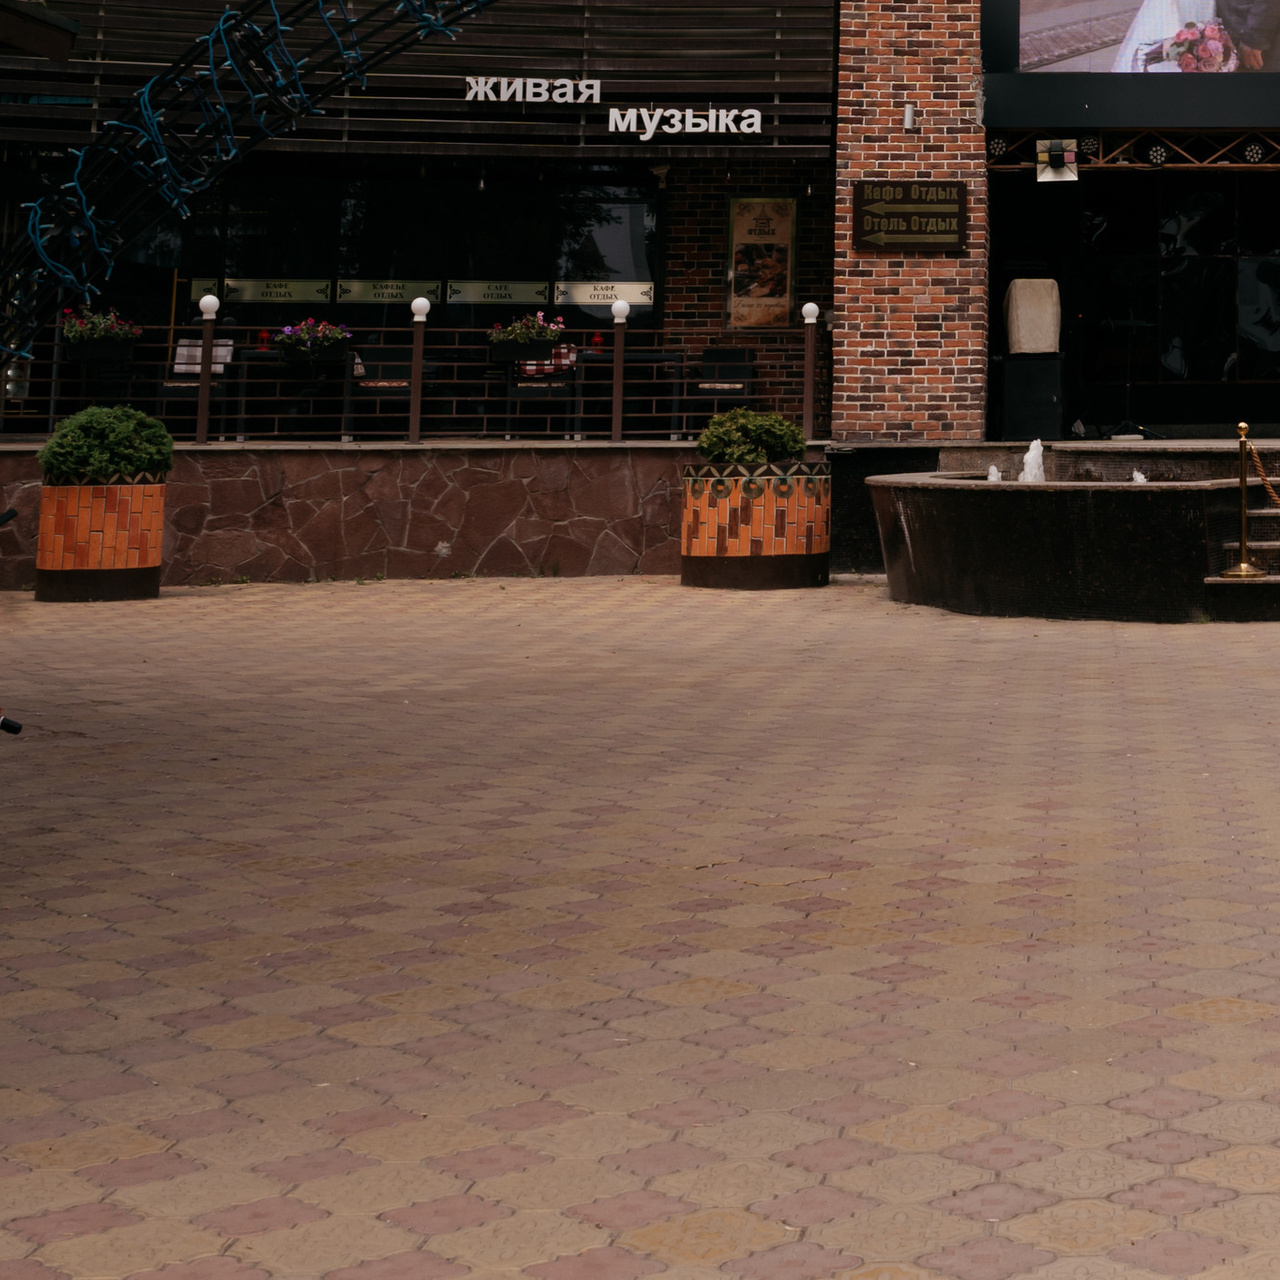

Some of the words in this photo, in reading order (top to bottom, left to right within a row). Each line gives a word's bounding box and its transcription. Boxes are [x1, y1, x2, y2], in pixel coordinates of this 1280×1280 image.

[465, 77, 601, 104] живая
[608, 108, 762, 141] музыка
[863, 184, 903, 201] Кафе
[911, 184, 959, 202] Отдых
[863, 215, 907, 231] Отель
[911, 215, 959, 233] Отдых
[589, 292, 619, 301] ОТДЫХ
